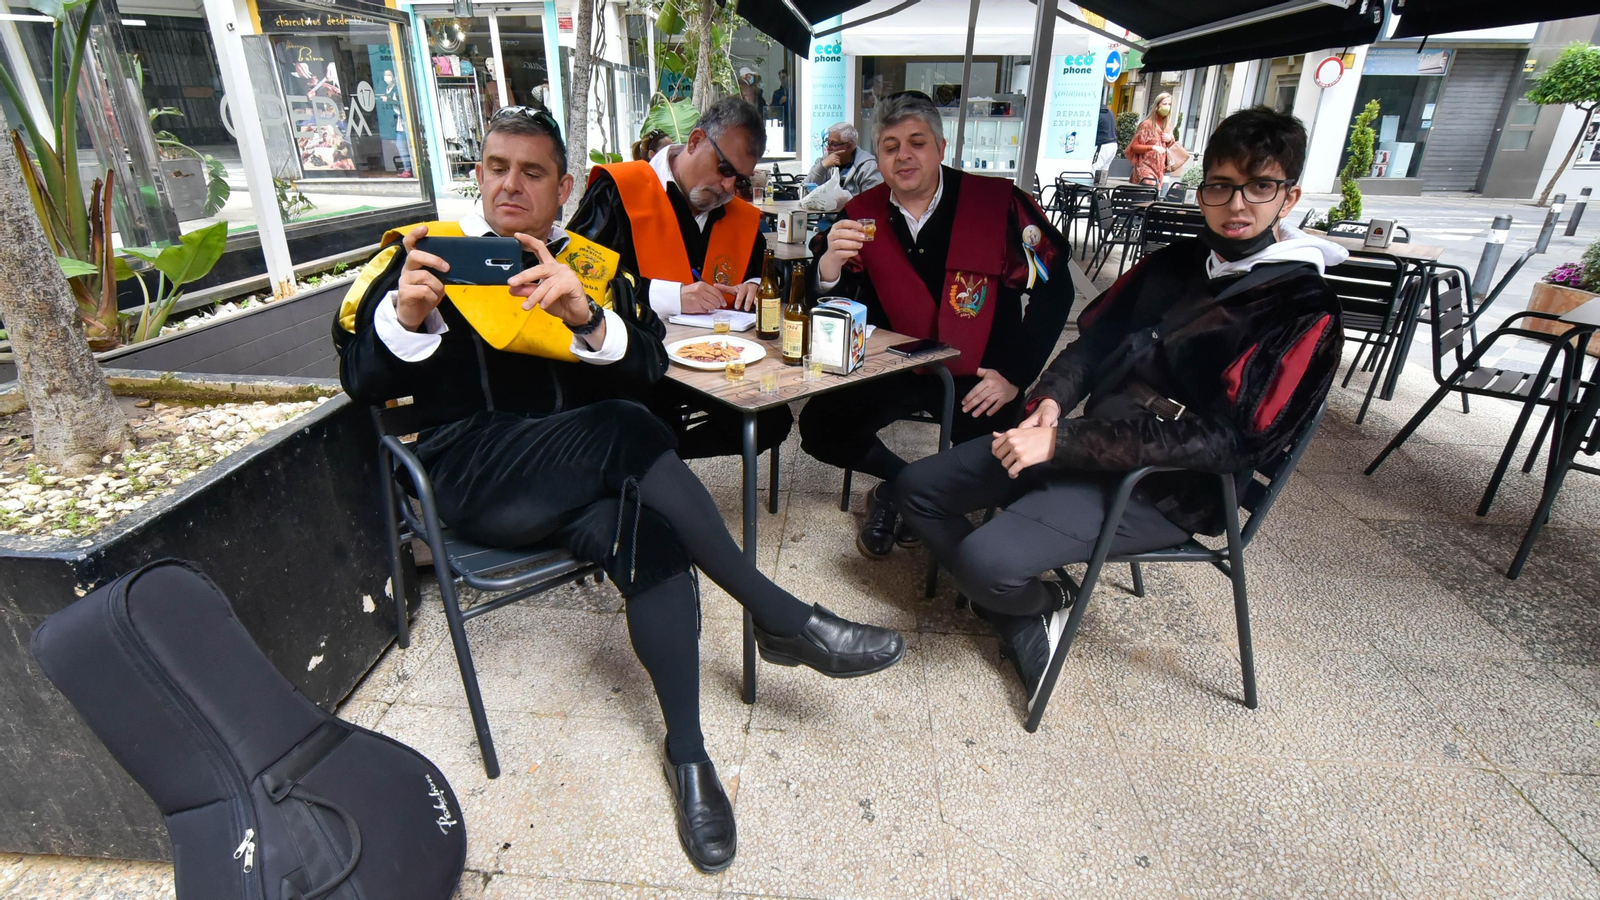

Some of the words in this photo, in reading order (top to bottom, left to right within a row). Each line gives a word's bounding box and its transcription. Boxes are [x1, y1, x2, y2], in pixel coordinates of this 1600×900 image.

[327, 14, 349, 26] desde
[815, 44, 842, 54] eco
[815, 55, 841, 63] phone
[1065, 55, 1093, 66] eco
[1063, 67, 1092, 75] phone
